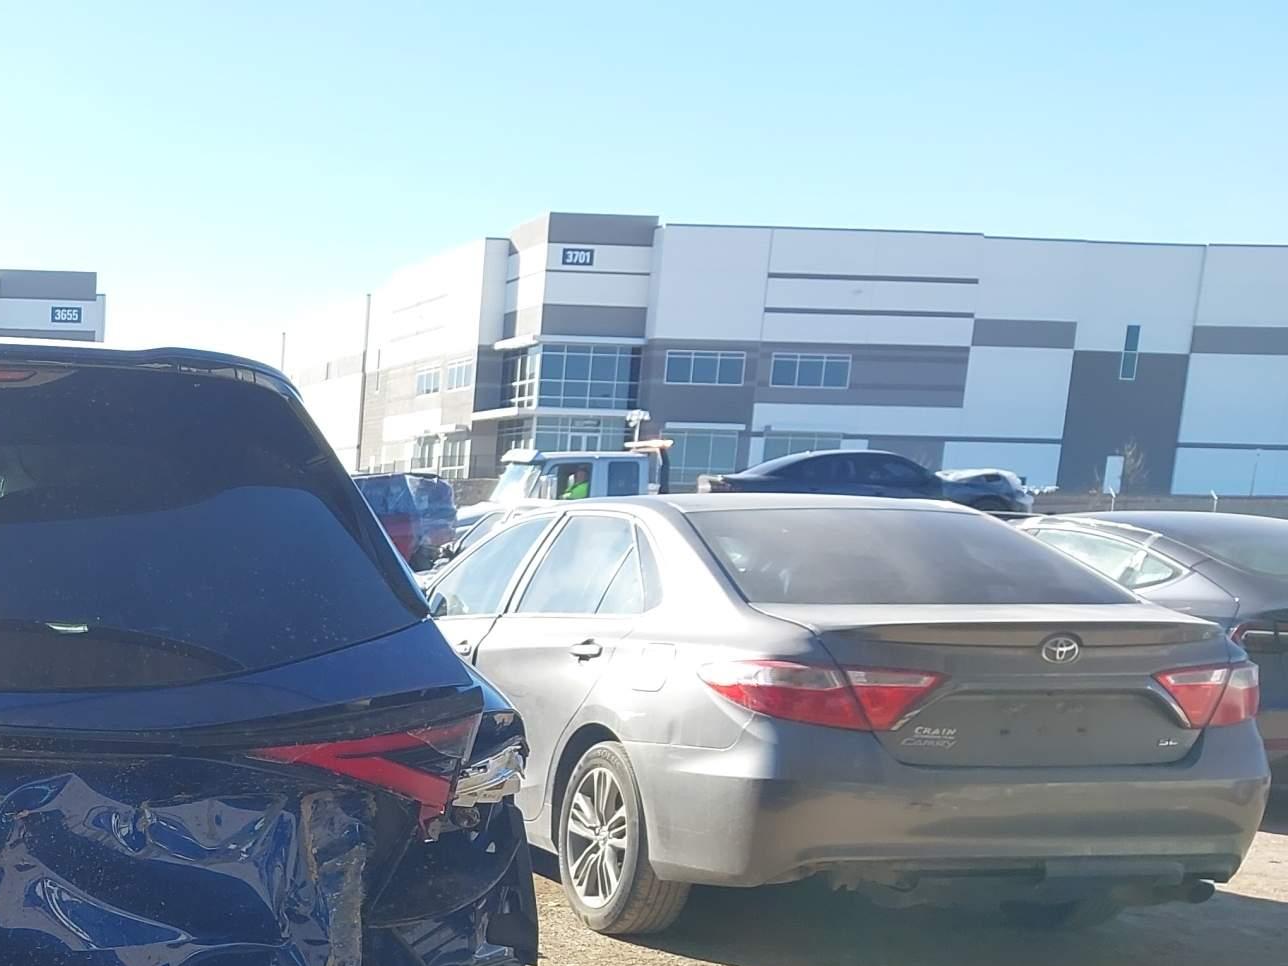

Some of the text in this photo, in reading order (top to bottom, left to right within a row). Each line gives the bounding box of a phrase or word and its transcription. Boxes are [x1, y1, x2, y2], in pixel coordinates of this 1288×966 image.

[566, 250, 591, 263] 3701
[55, 309, 79, 321] 3655
[914, 726, 957, 736] CRAIN
